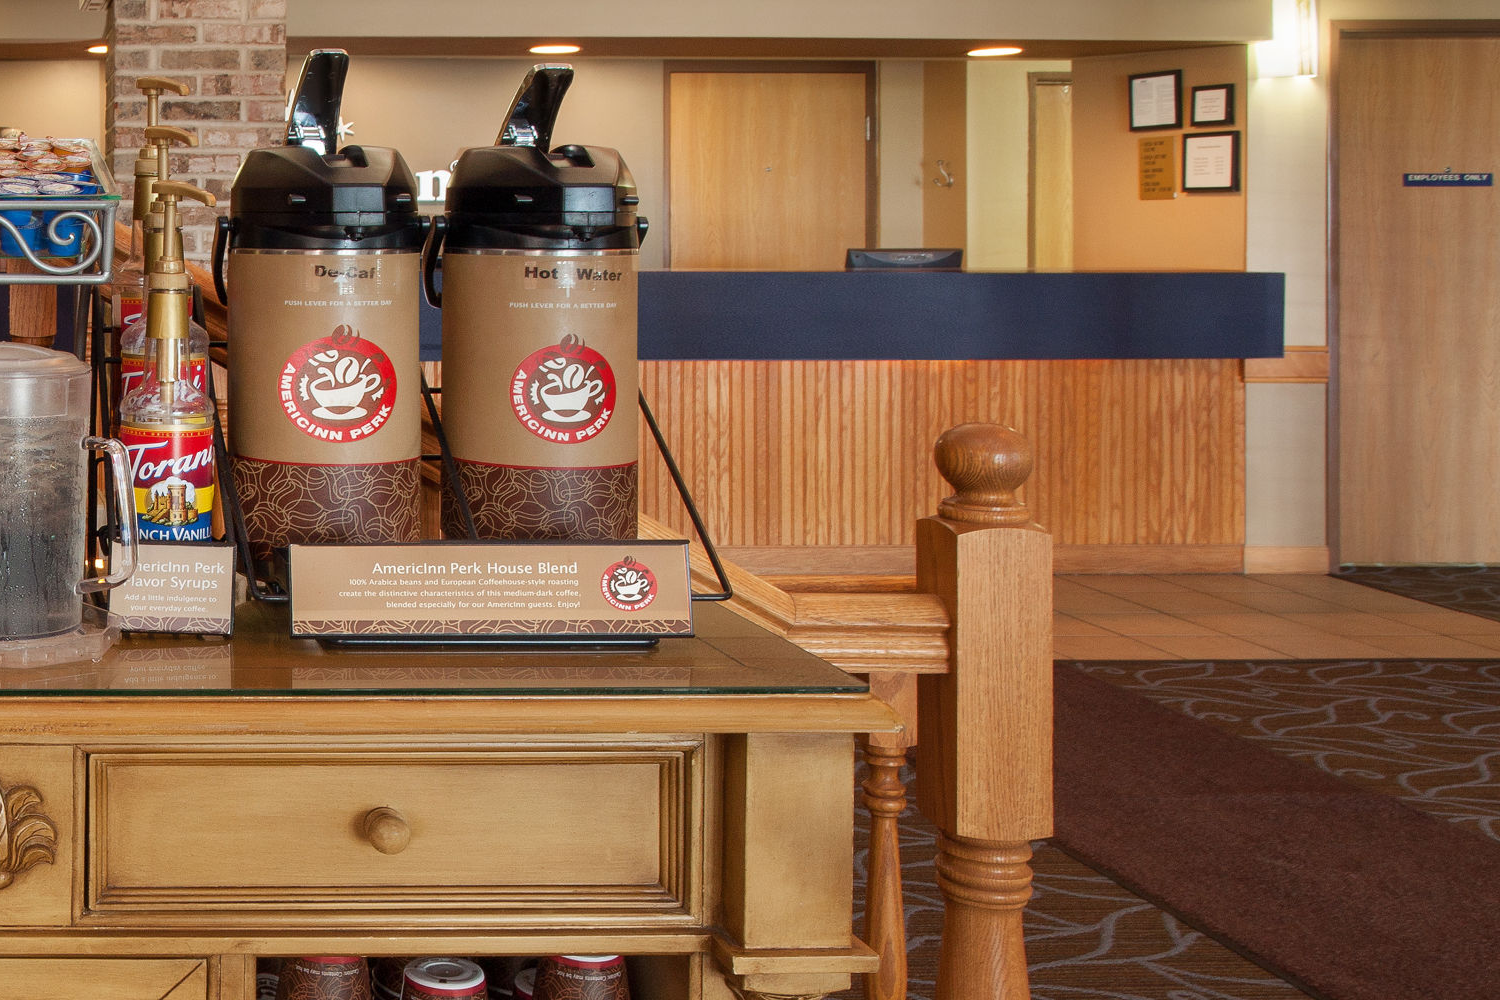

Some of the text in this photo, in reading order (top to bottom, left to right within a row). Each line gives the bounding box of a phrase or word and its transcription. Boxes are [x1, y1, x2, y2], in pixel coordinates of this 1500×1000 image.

[525, 267, 622, 281] Hot Water
[280, 363, 391, 441] AMERICINN PERK
[513, 369, 612, 442] AMERICINN PERK
[127, 434, 214, 483] Torani
[195, 562, 225, 574] Perk
[372, 562, 578, 574] AmericInn Perk House Blend
[170, 576, 218, 590] Syrups
[441, 579, 476, 587] European
[548, 579, 579, 587] roasting
[167, 595, 206, 603] indulgence
[557, 590, 581, 598] coffee,
[601, 574, 655, 611] AMERICINN PERK
[419, 601, 456, 609] especially
[558, 601, 581, 609] Enjoy!
